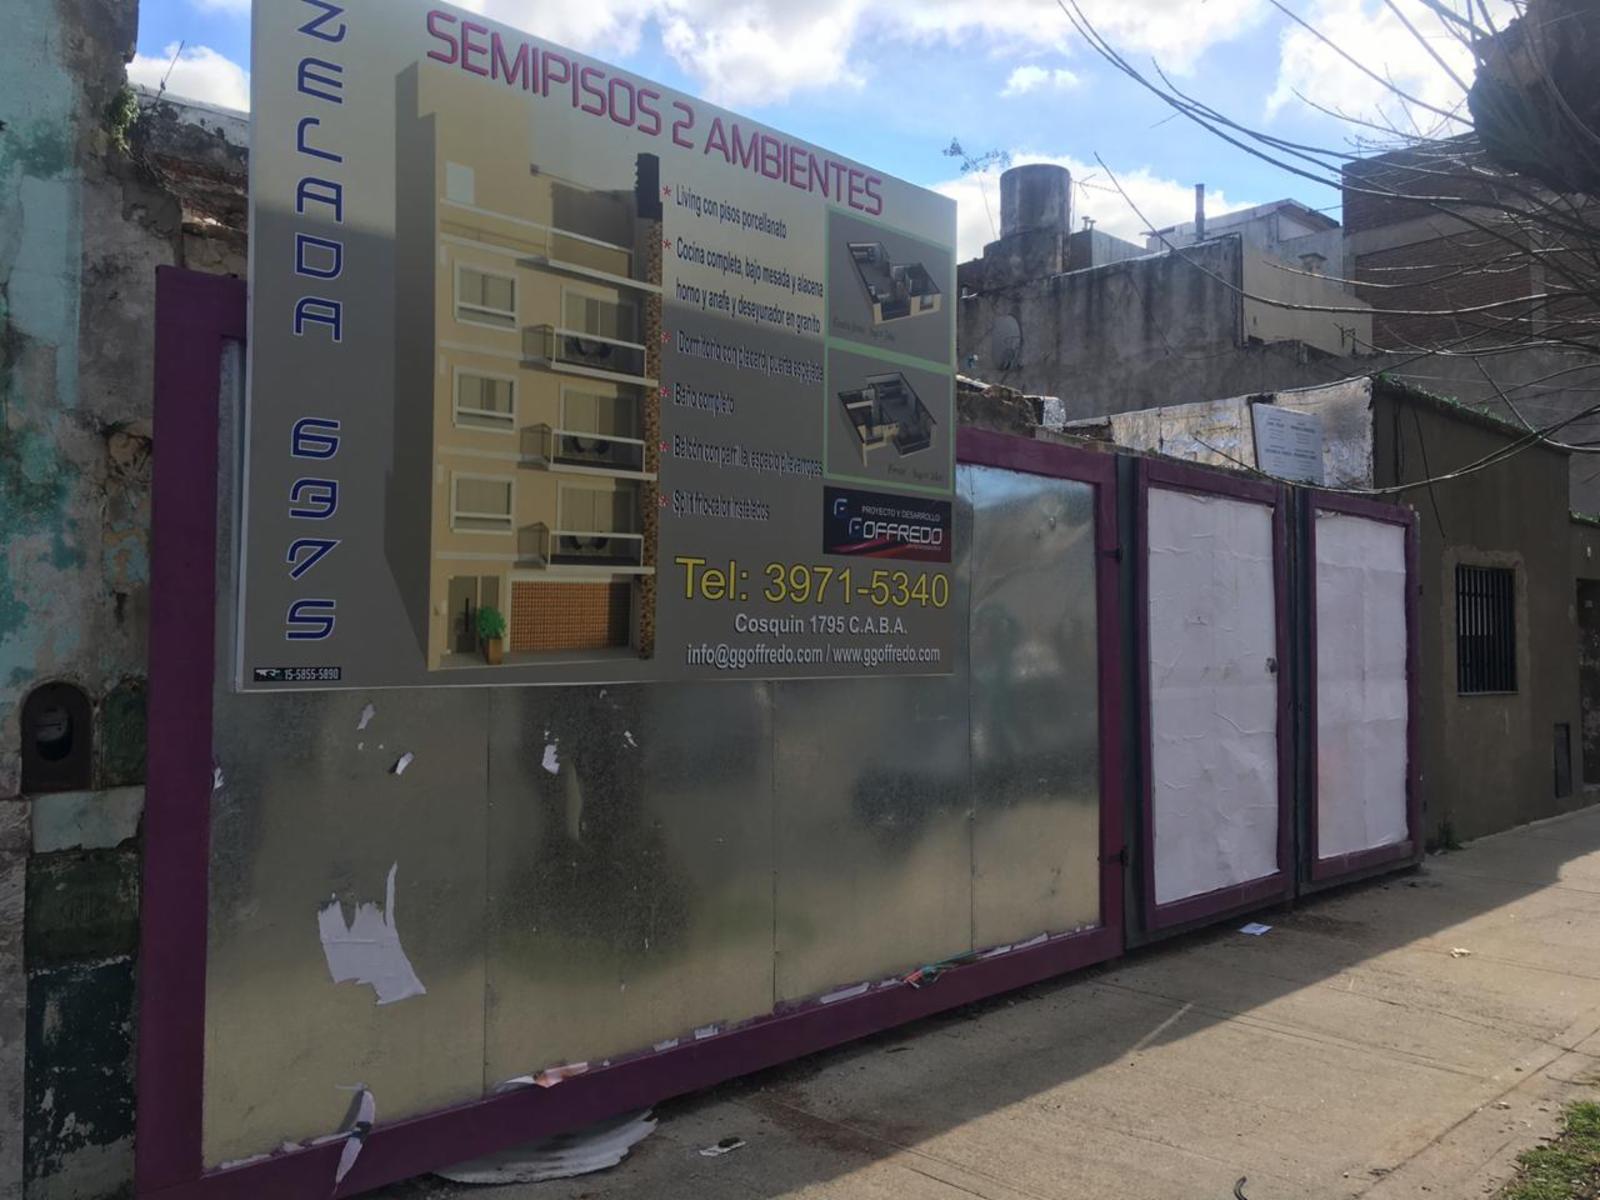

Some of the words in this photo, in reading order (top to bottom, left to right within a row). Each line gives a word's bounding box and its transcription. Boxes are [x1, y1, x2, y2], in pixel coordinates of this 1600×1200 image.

[426, 9, 662, 137] SEMIPISOS
[672, 100, 696, 149] 2
[704, 116, 884, 216] AMBIENTES
[293, 0, 347, 342] ZELADA
[676, 184, 701, 217] Living
[703, 197, 718, 216] con
[720, 200, 741, 224] pisos
[742, 210, 787, 239] porcellanato
[676, 236, 705, 264] Cocina
[745, 256, 761, 284] bajo
[763, 266, 790, 288] mesada
[676, 277, 700, 303] horno
[708, 290, 730, 310] anafe
[786, 311, 795, 327] en
[797, 313, 821, 334] granito
[697, 390, 735, 418] completo
[862, 505, 896, 518] PROYECTO
[901, 510, 941, 522] DESARROLLO
[674, 556, 750, 601] Tel:
[762, 562, 949, 608] 3971-5340
[734, 612, 804, 636] Cosquin
[809, 616, 845, 634] 1795
[849, 616, 908, 635] C.A.B.A.
[687, 643, 823, 669] info@ggoffredo.com
[832, 644, 941, 667] www.ggoffredo.com
